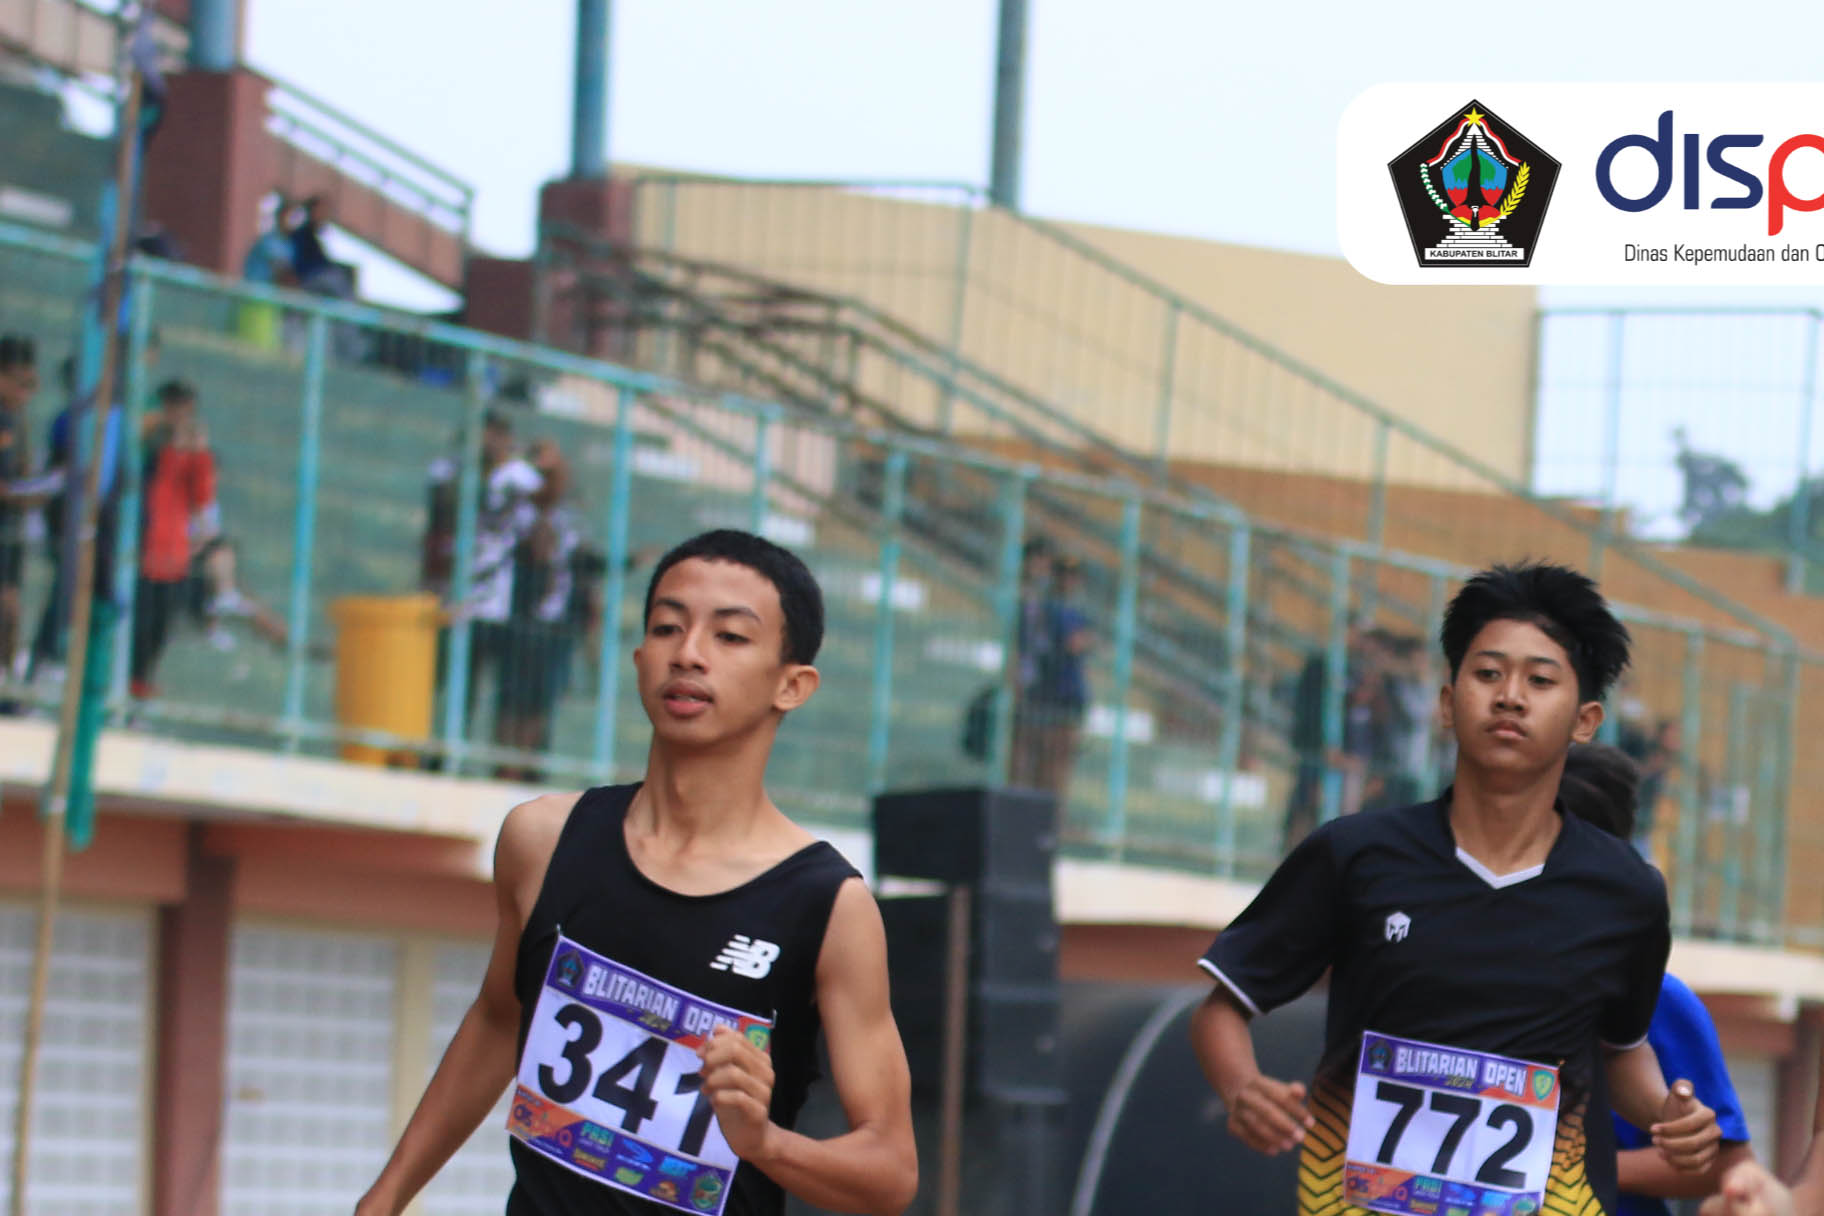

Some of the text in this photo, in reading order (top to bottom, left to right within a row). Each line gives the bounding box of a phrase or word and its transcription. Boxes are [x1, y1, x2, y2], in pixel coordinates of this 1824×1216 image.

[582, 964, 680, 1023] BLITARIAN
[538, 1002, 716, 1158] 341
[1395, 1046, 1527, 1097] BLITARIAN OPEN
[1376, 1080, 1534, 1190] 772
